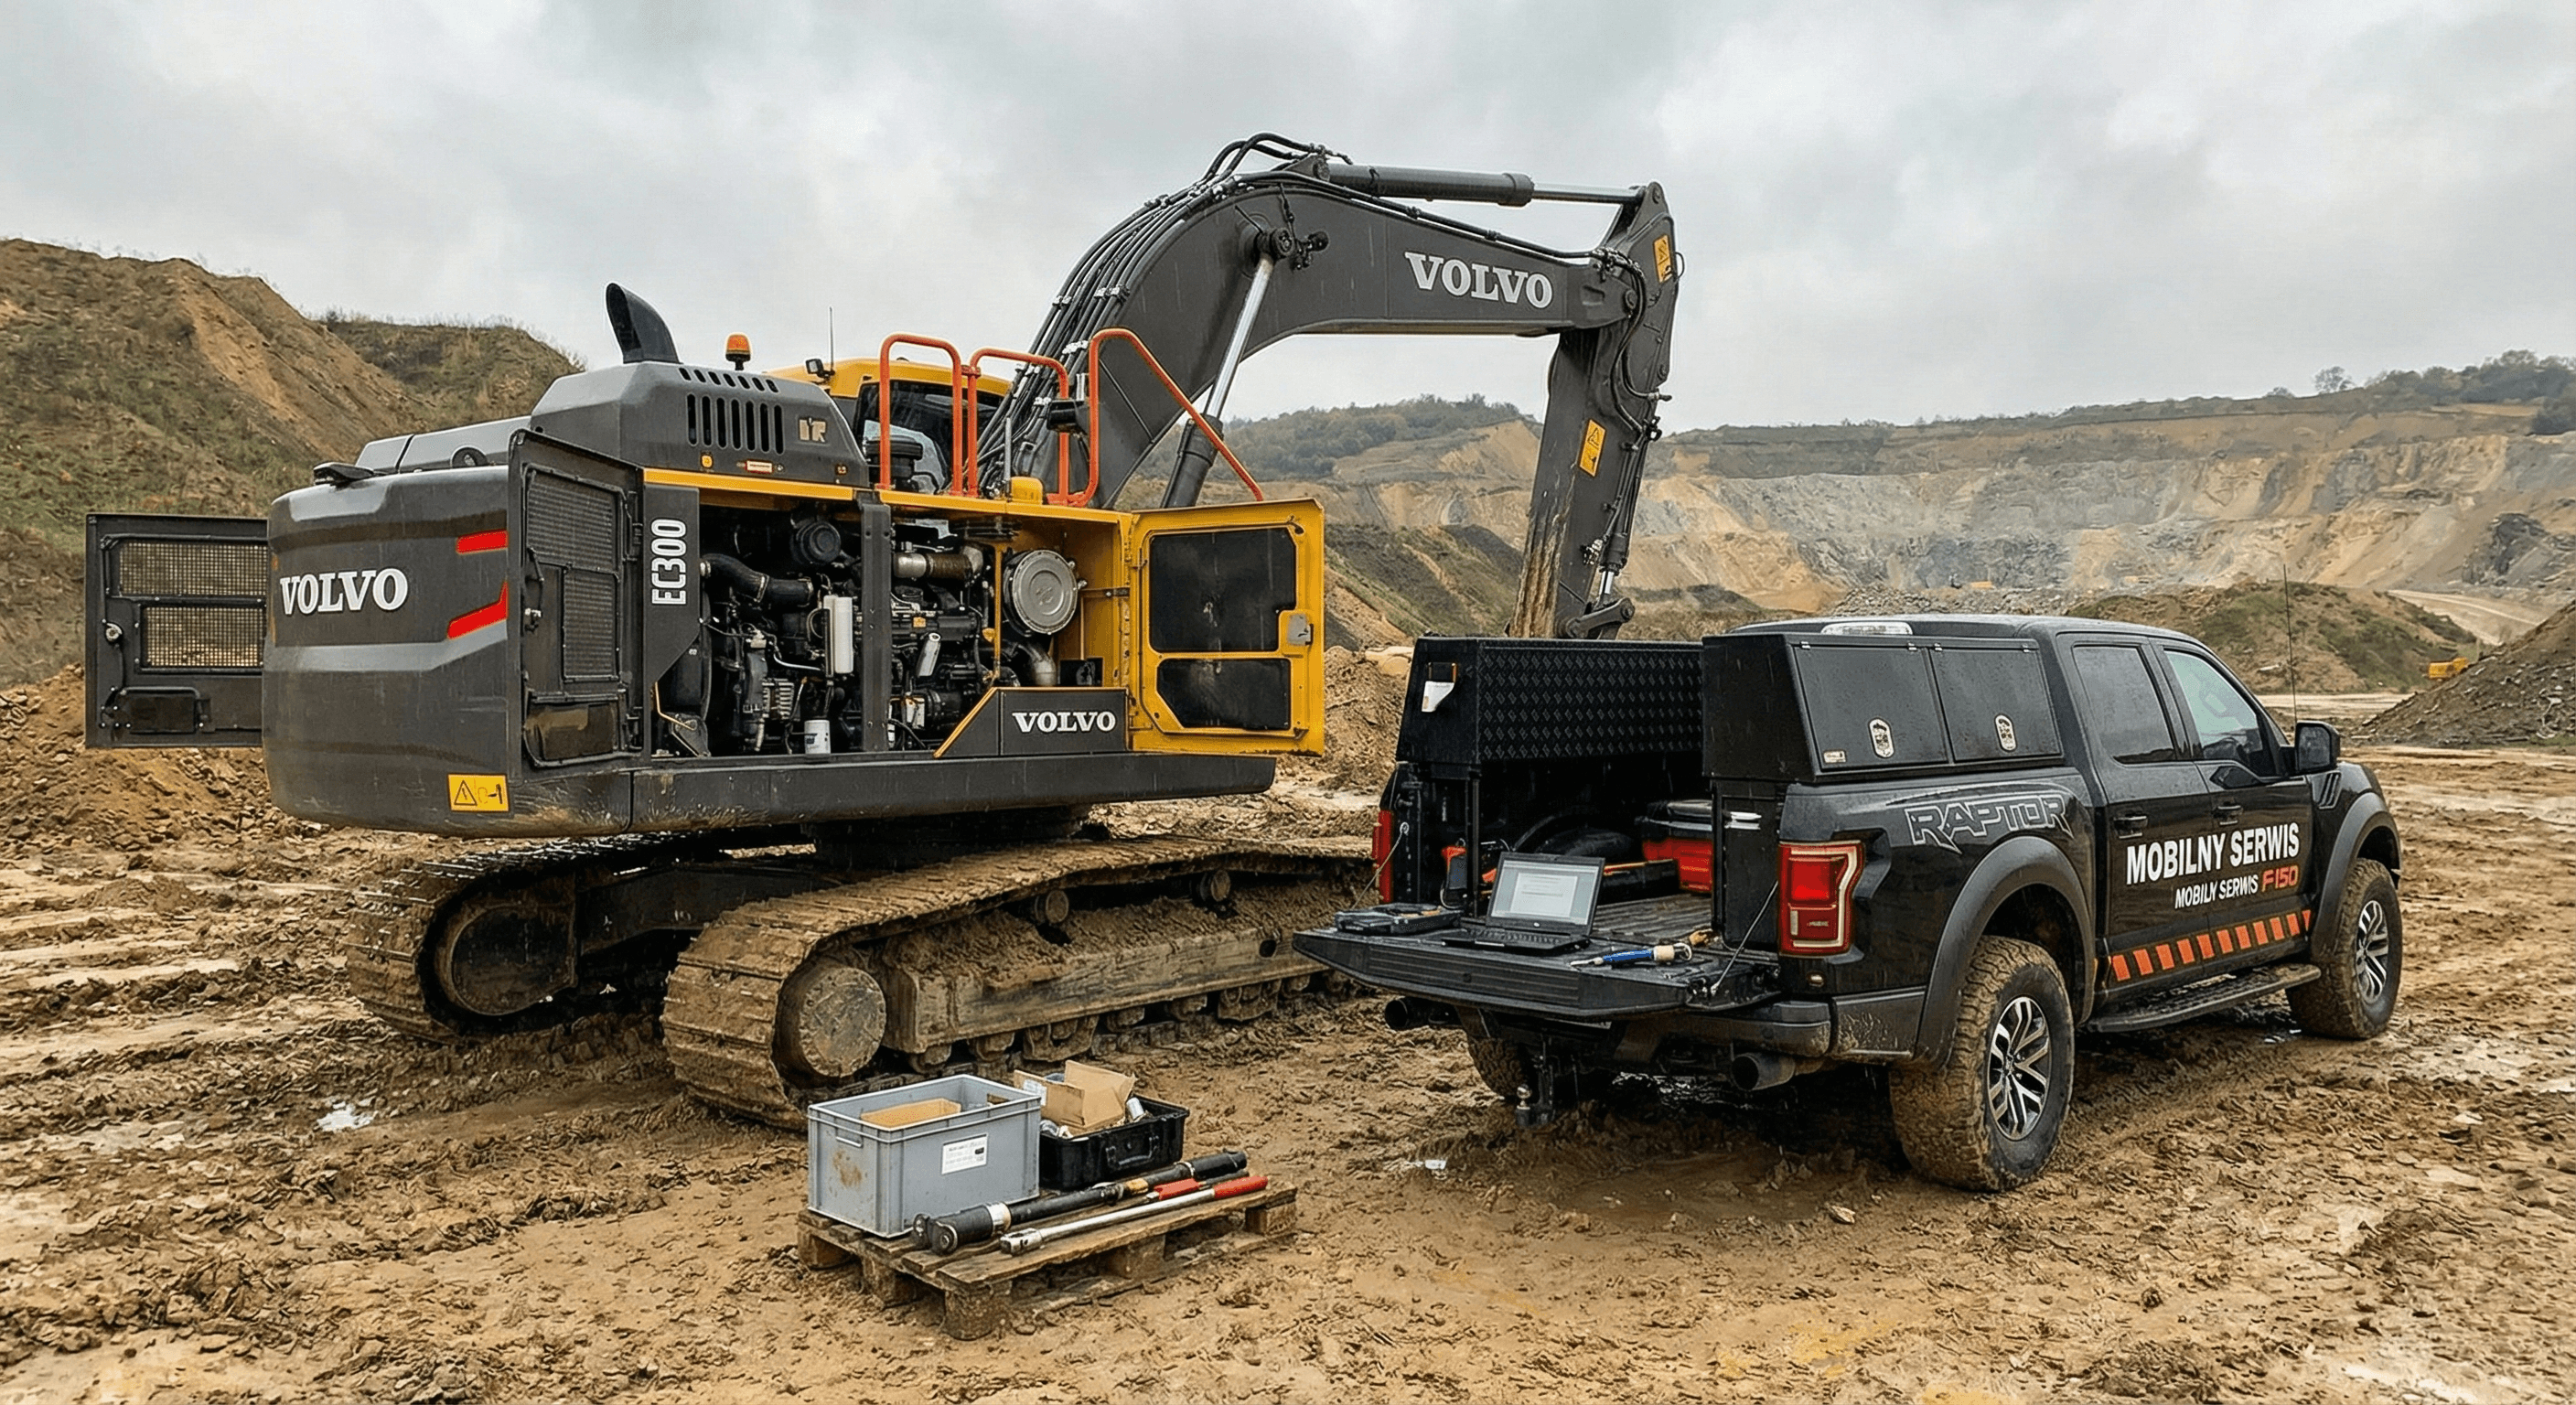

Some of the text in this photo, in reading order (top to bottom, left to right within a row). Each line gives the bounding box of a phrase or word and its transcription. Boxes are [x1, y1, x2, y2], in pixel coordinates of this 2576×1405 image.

[1404, 251, 1553, 309] VOLVO
[279, 567, 409, 616] VOLVO
[650, 519, 687, 606] EC300
[1012, 711, 1116, 734] VOLVO
[1905, 794, 2074, 854] RAPTOR
[2126, 821, 2300, 885] MOBILNY SERWIS
[2218, 874, 2259, 900] SERWIS
[2261, 864, 2299, 893] F150
